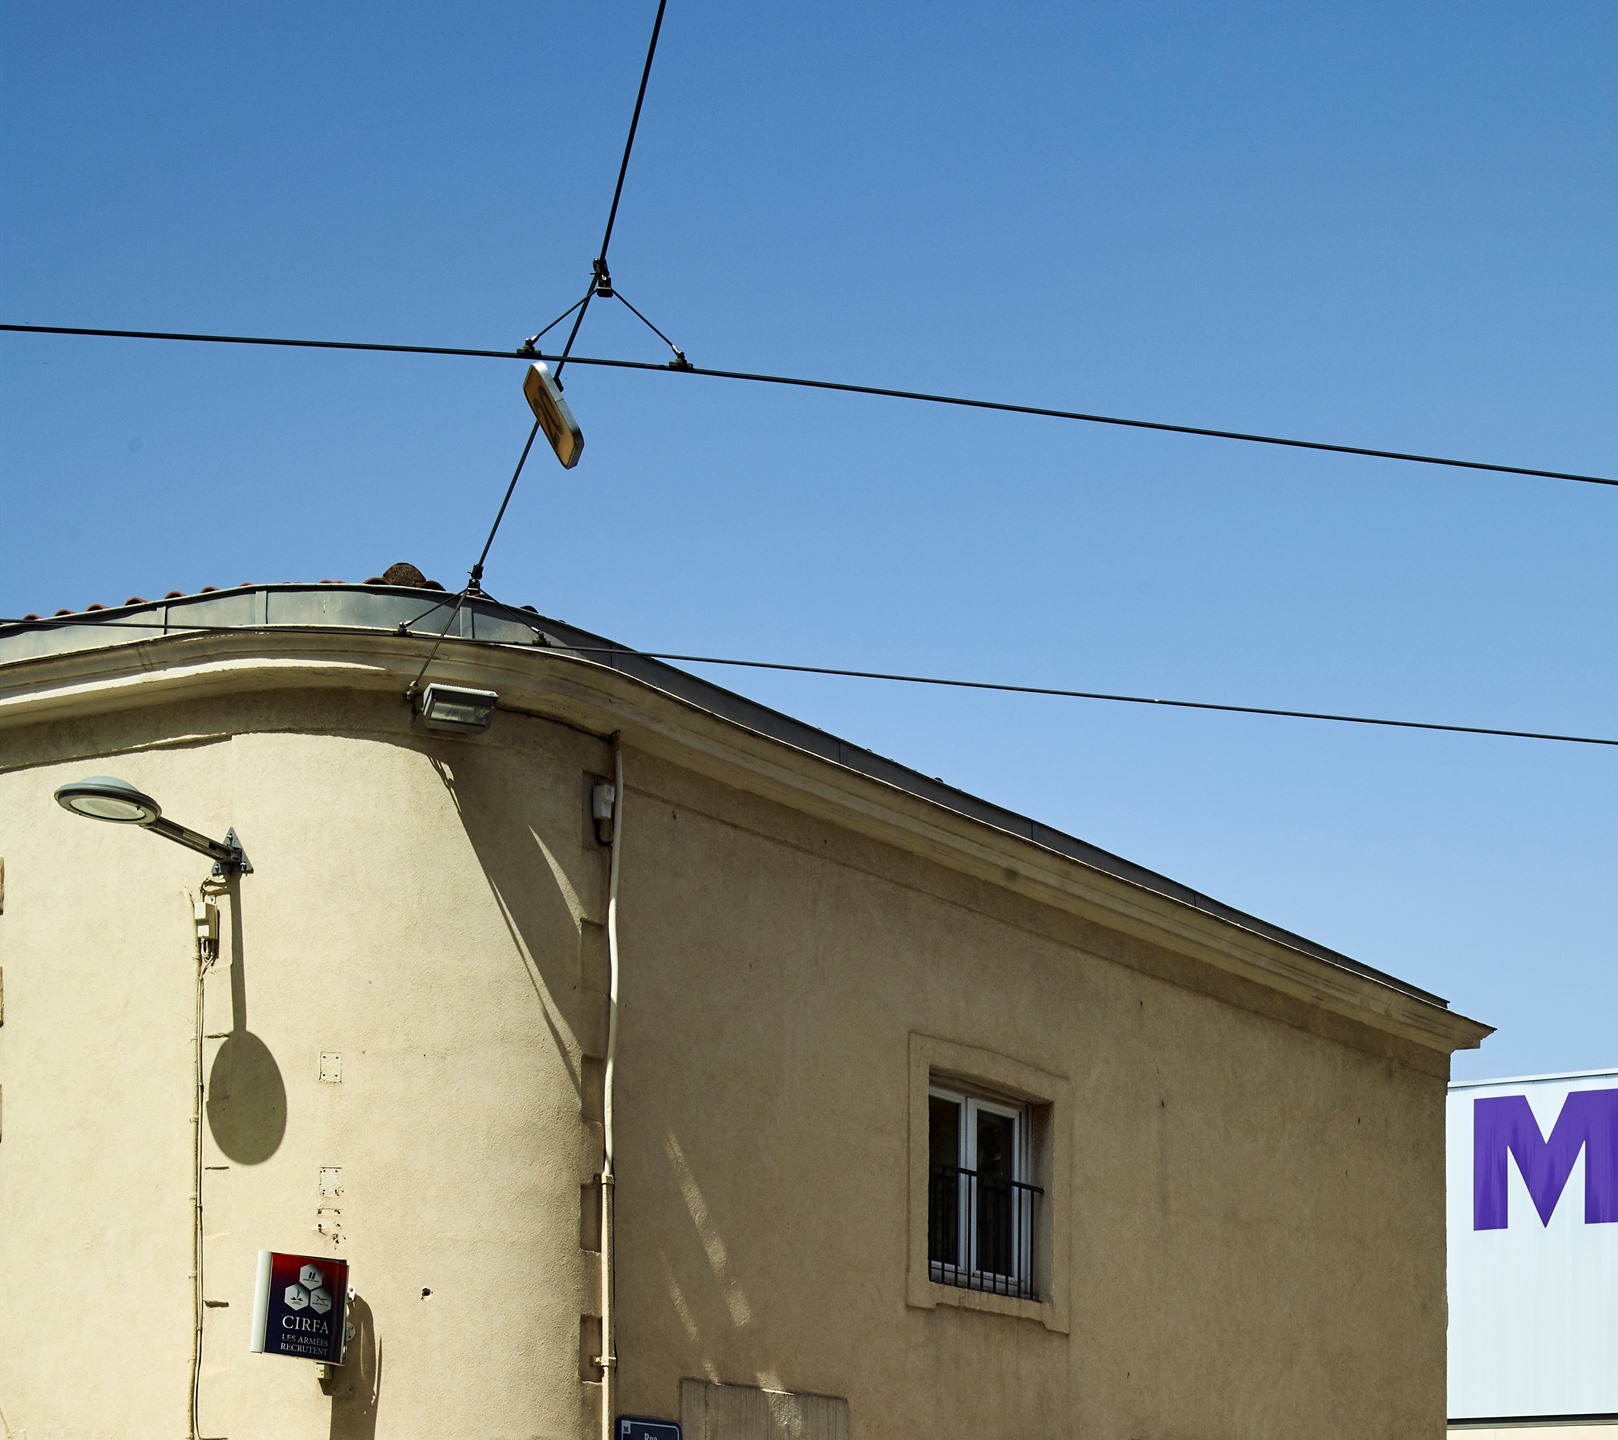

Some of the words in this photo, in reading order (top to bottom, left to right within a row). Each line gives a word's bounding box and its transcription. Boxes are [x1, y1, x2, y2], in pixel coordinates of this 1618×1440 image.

[282, 1315, 329, 1334] CIRFA
[281, 1333, 296, 1342] LES
[280, 1342, 328, 1356] RECRUTENT
